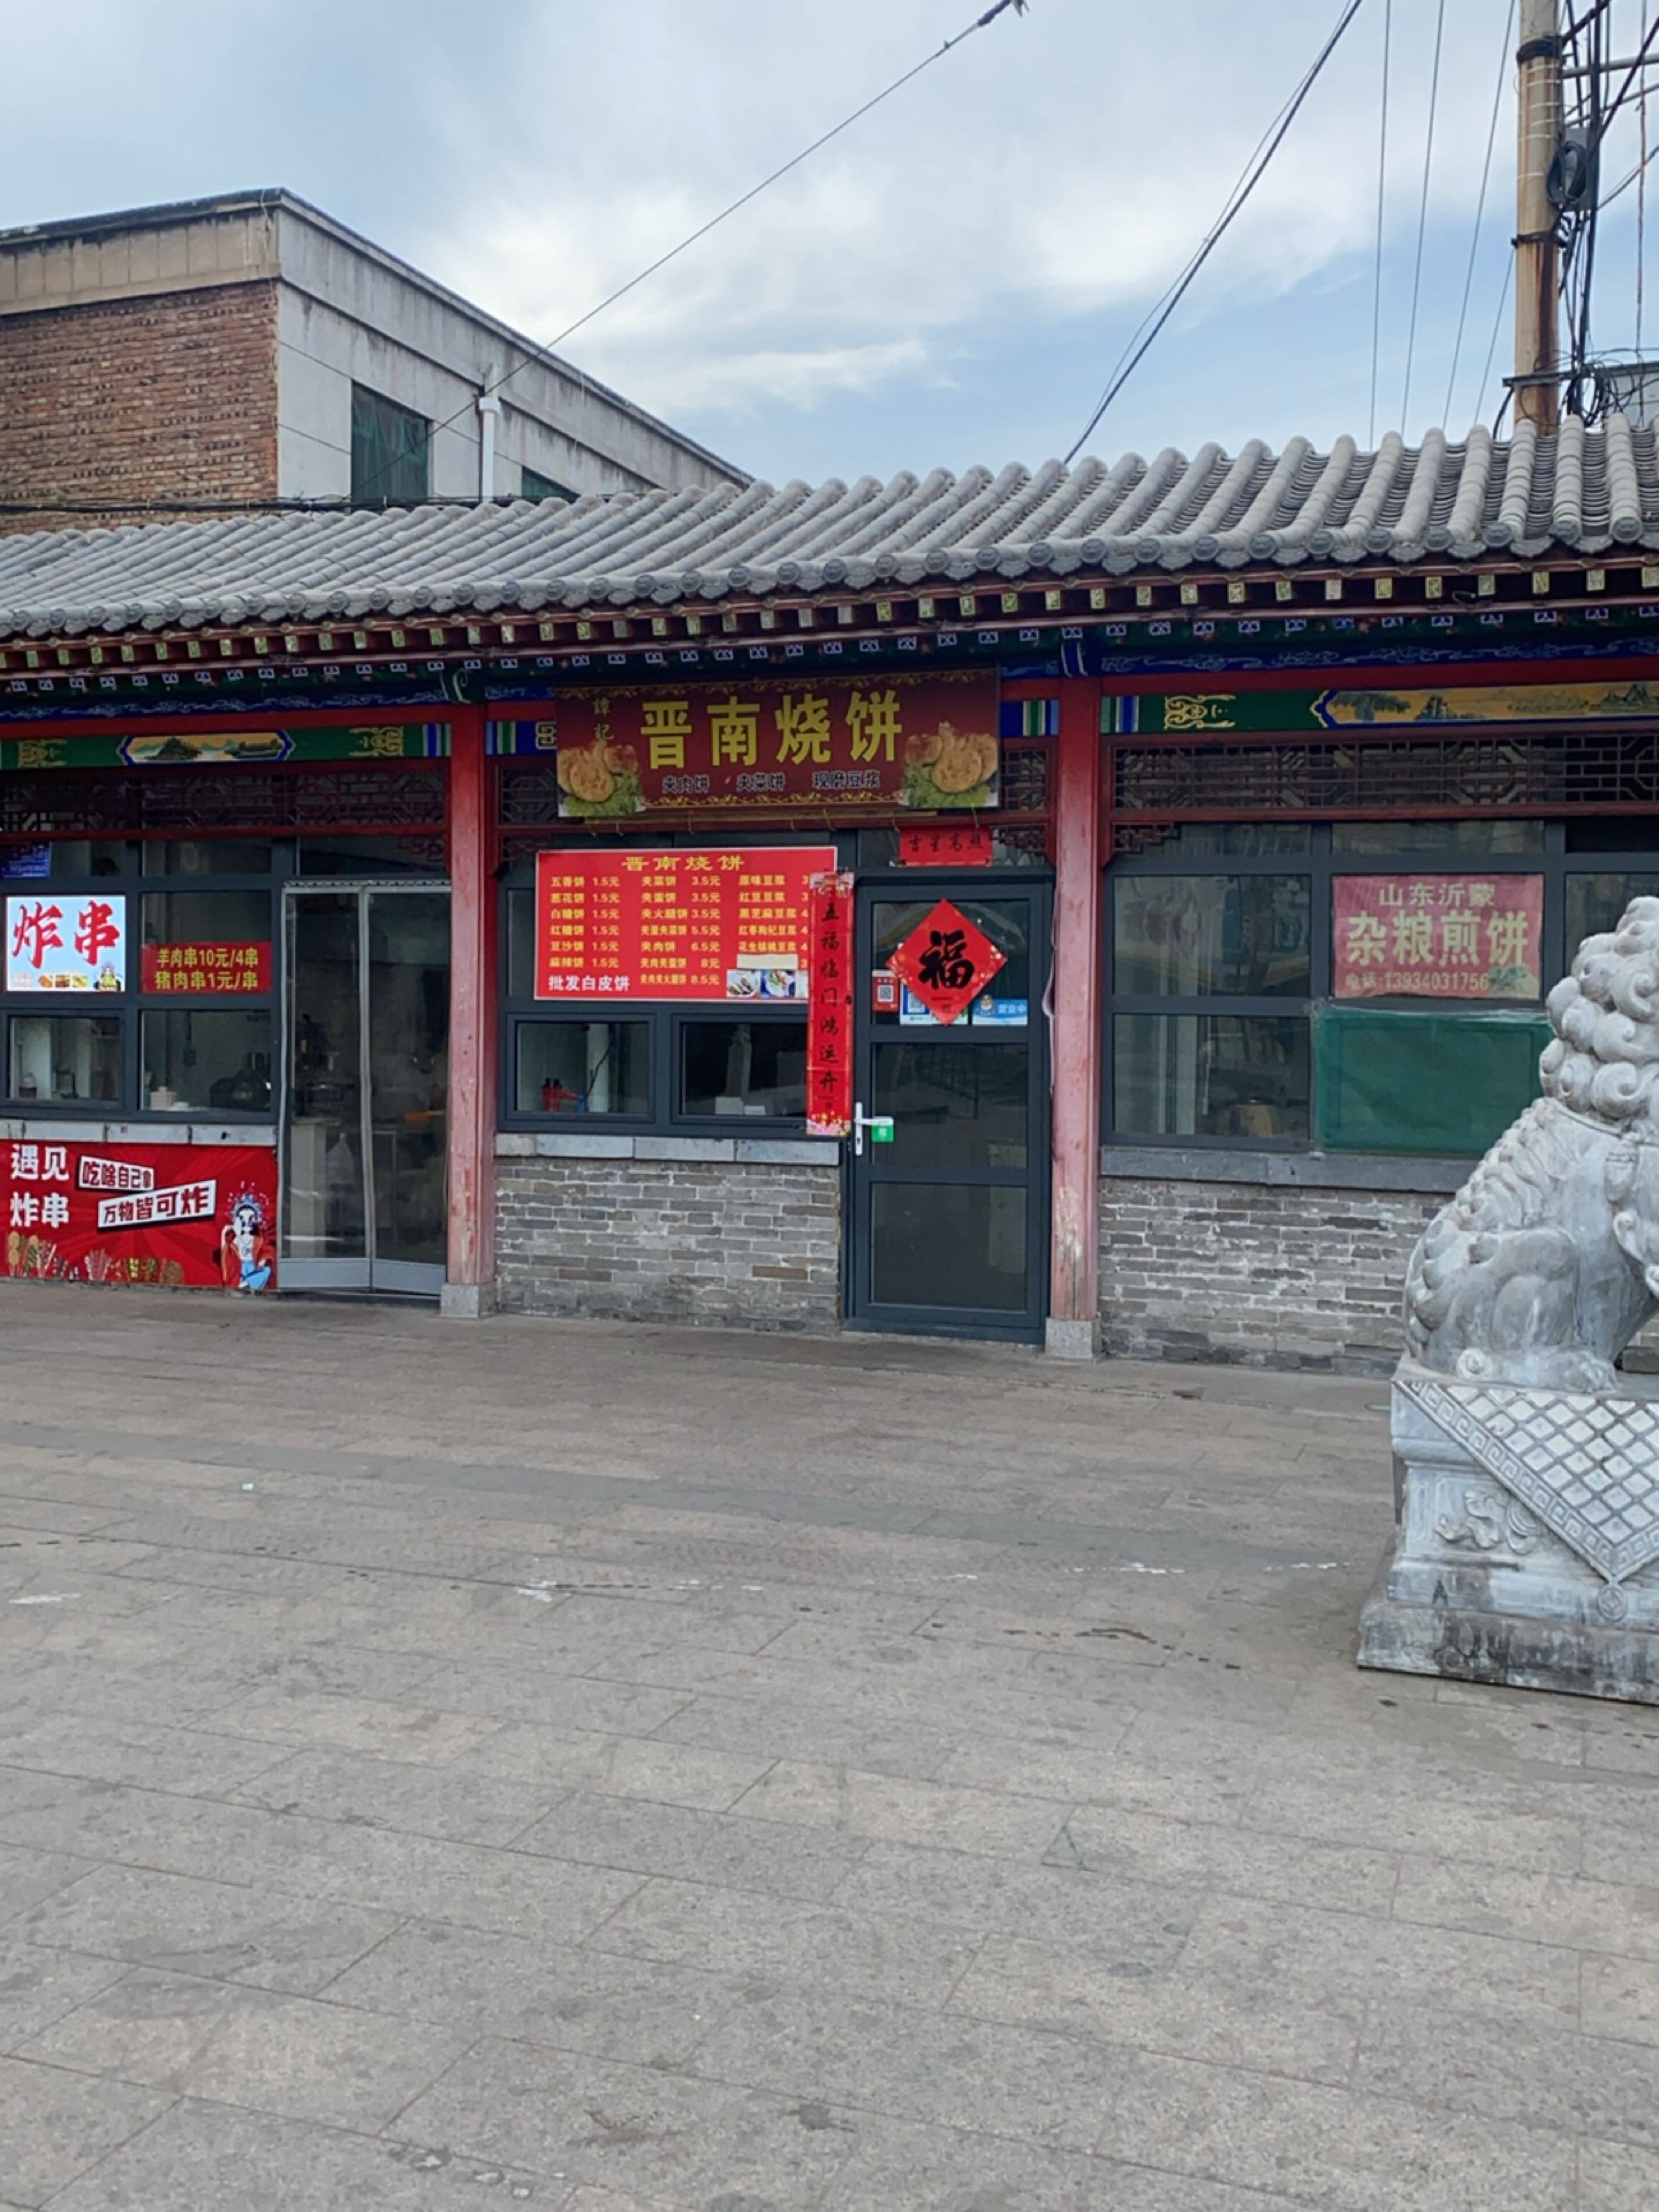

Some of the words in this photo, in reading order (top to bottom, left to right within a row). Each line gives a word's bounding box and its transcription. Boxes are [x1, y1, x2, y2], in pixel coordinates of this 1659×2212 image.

[640, 689, 903, 769] 晋南烧饼
[662, 773, 710, 794] 夹肉饼
[736, 772, 785, 792] 夹菜饼
[812, 770, 881, 789] 现磨豆浆
[621, 855, 744, 871] 晋南烧饼
[552, 876, 584, 886] 五香饼
[593, 876, 620, 886] 1.5元
[692, 876, 721, 886] 3.5元
[593, 893, 620, 903] 1.5元
[692, 892, 720, 902] 3.5元
[1378, 883, 1496, 908] 山东沂蒙
[593, 909, 620, 919] 1.5元
[642, 909, 687, 918] 夹火腿饼
[692, 908, 721, 919] 3.5元
[12, 900, 120, 970] 炸串
[593, 925, 620, 936] 1.5元
[691, 925, 720, 936] 5.5元
[1347, 910, 1529, 967] 杂粮煎饼
[551, 941, 584, 951] 豆沙饼
[593, 941, 619, 952] 1.5元
[641, 941, 676, 952] 夹肉饼
[691, 942, 720, 952] 6.5元
[157, 949, 259, 967] 羊肉串10元/4串
[593, 958, 619, 968] 1.5元
[918, 929, 975, 990] 福
[155, 972, 259, 990] 猪肉串1元/串
[549, 975, 629, 991] 批发白皮饼
[10, 1144, 70, 1182] 遇见
[82, 1161, 152, 1189] 吃啥自己拿
[10, 1191, 69, 1228] 炸串
[104, 1185, 209, 1225] 万物皆可炸
